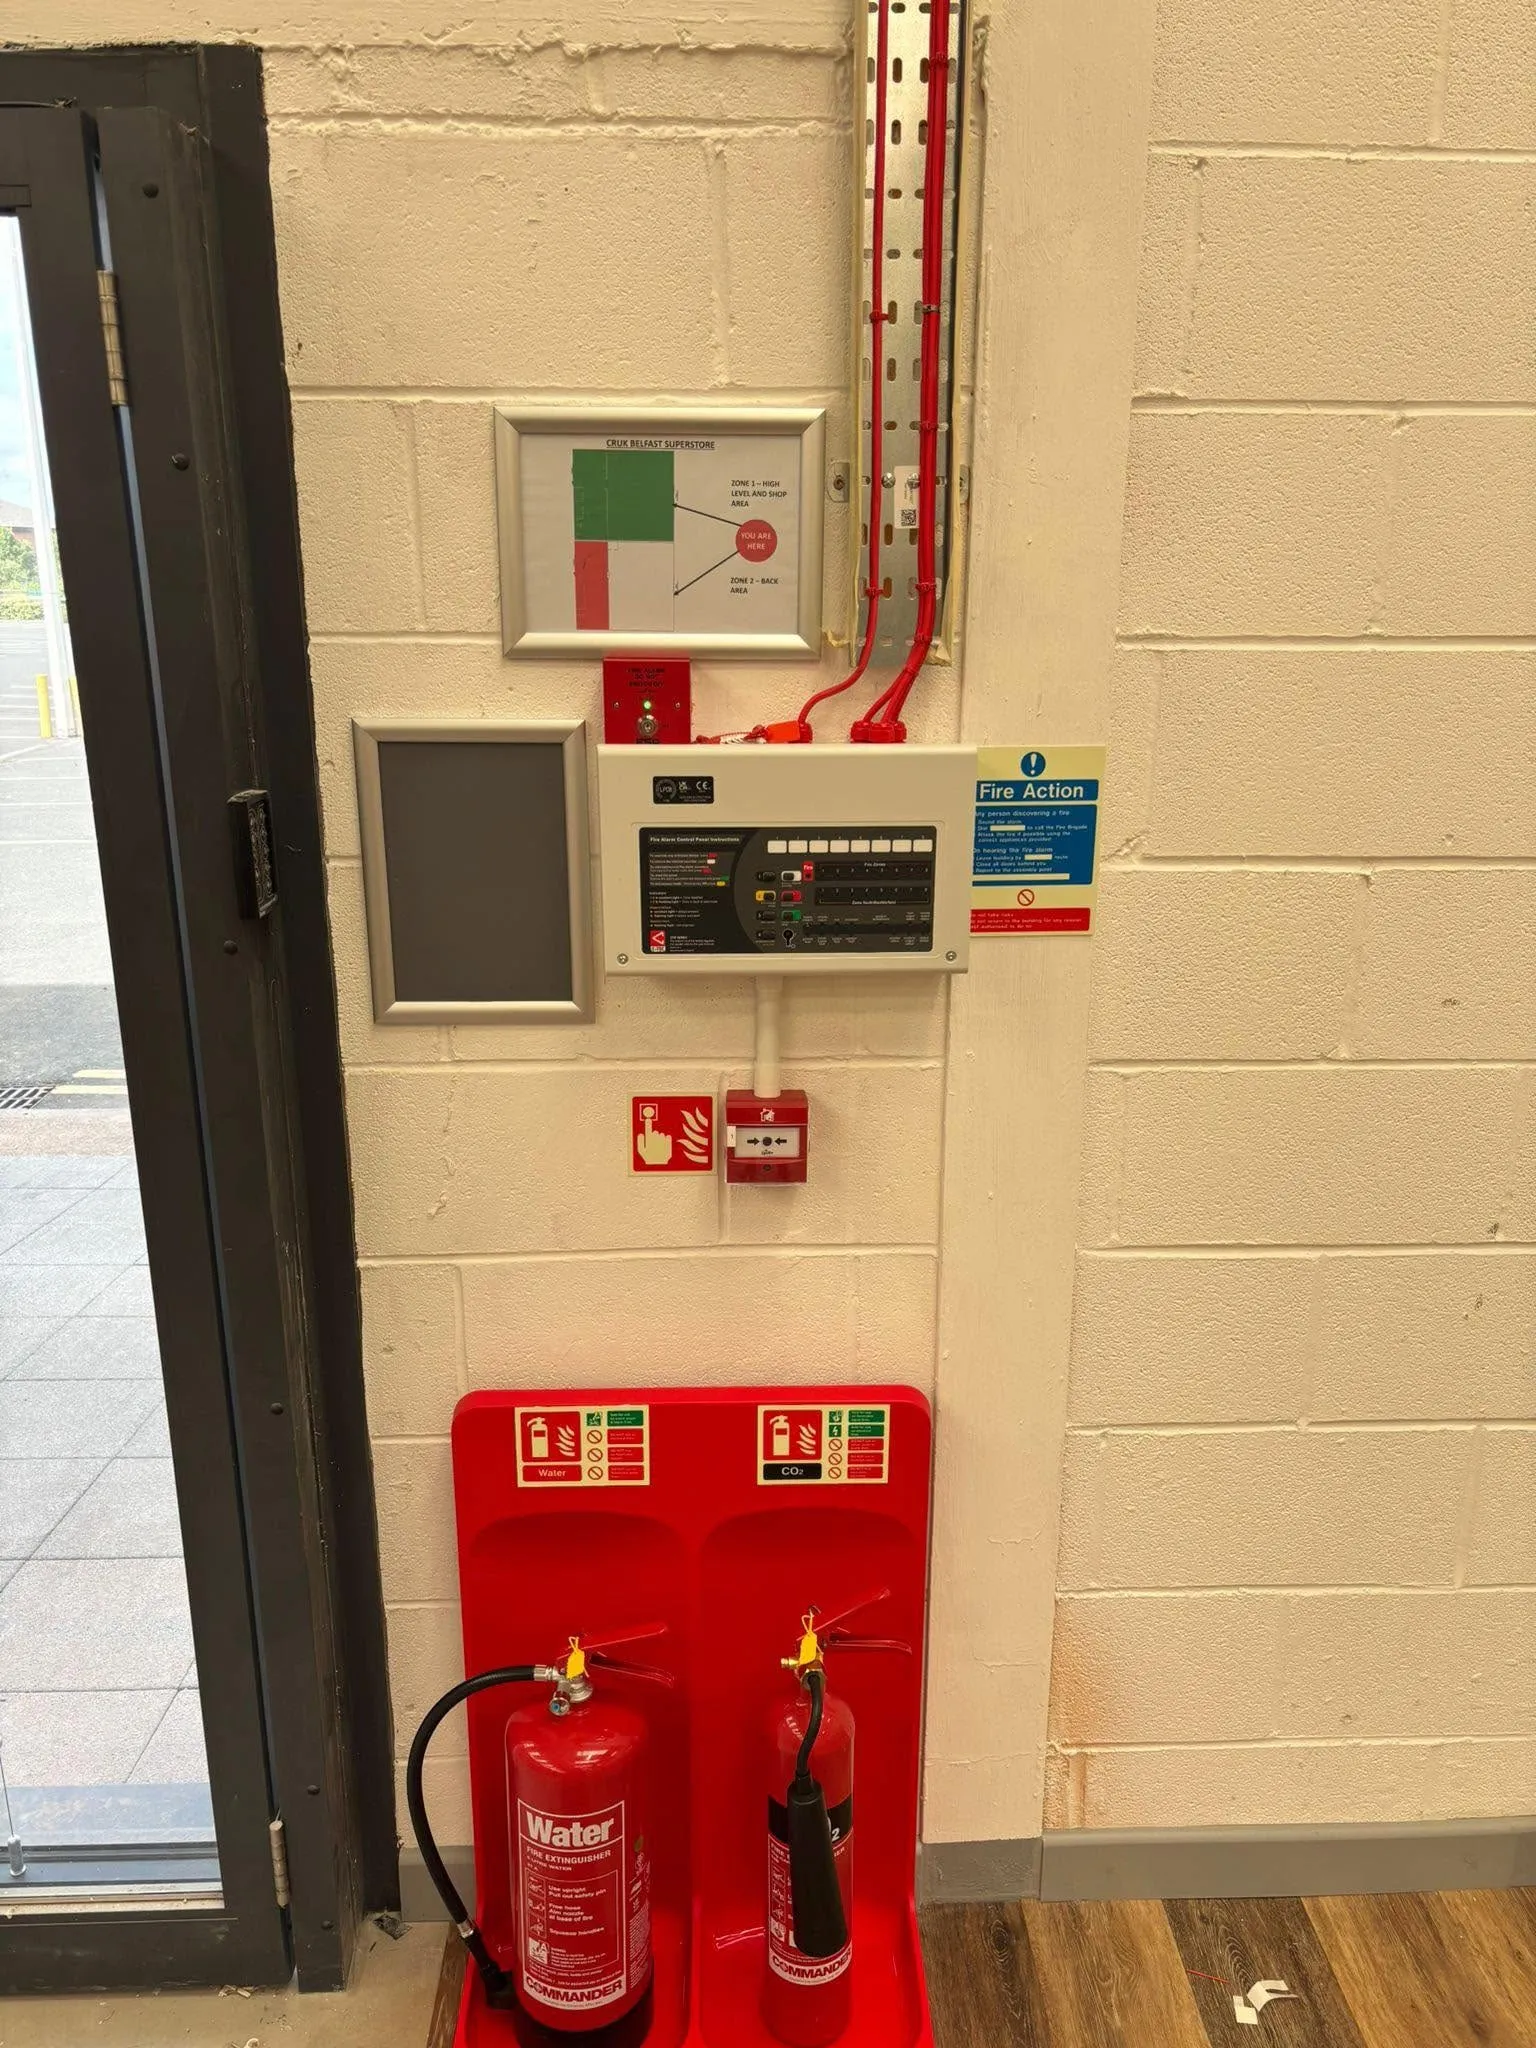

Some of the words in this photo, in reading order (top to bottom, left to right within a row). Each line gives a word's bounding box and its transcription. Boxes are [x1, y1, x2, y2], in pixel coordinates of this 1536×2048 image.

[606, 440, 628, 448] CRUK
[630, 440, 662, 448] BELFAST
[664, 440, 715, 448] SUPERSTORE
[979, 783, 1014, 799] Fire
[1022, 783, 1084, 799] Action
[538, 1468, 566, 1478] Water
[526, 1811, 614, 1847] Water
[527, 1846, 543, 1859] FIRE
[545, 1850, 611, 1864] EXTINGUISHER
[526, 1976, 622, 2002] COMMANDER
